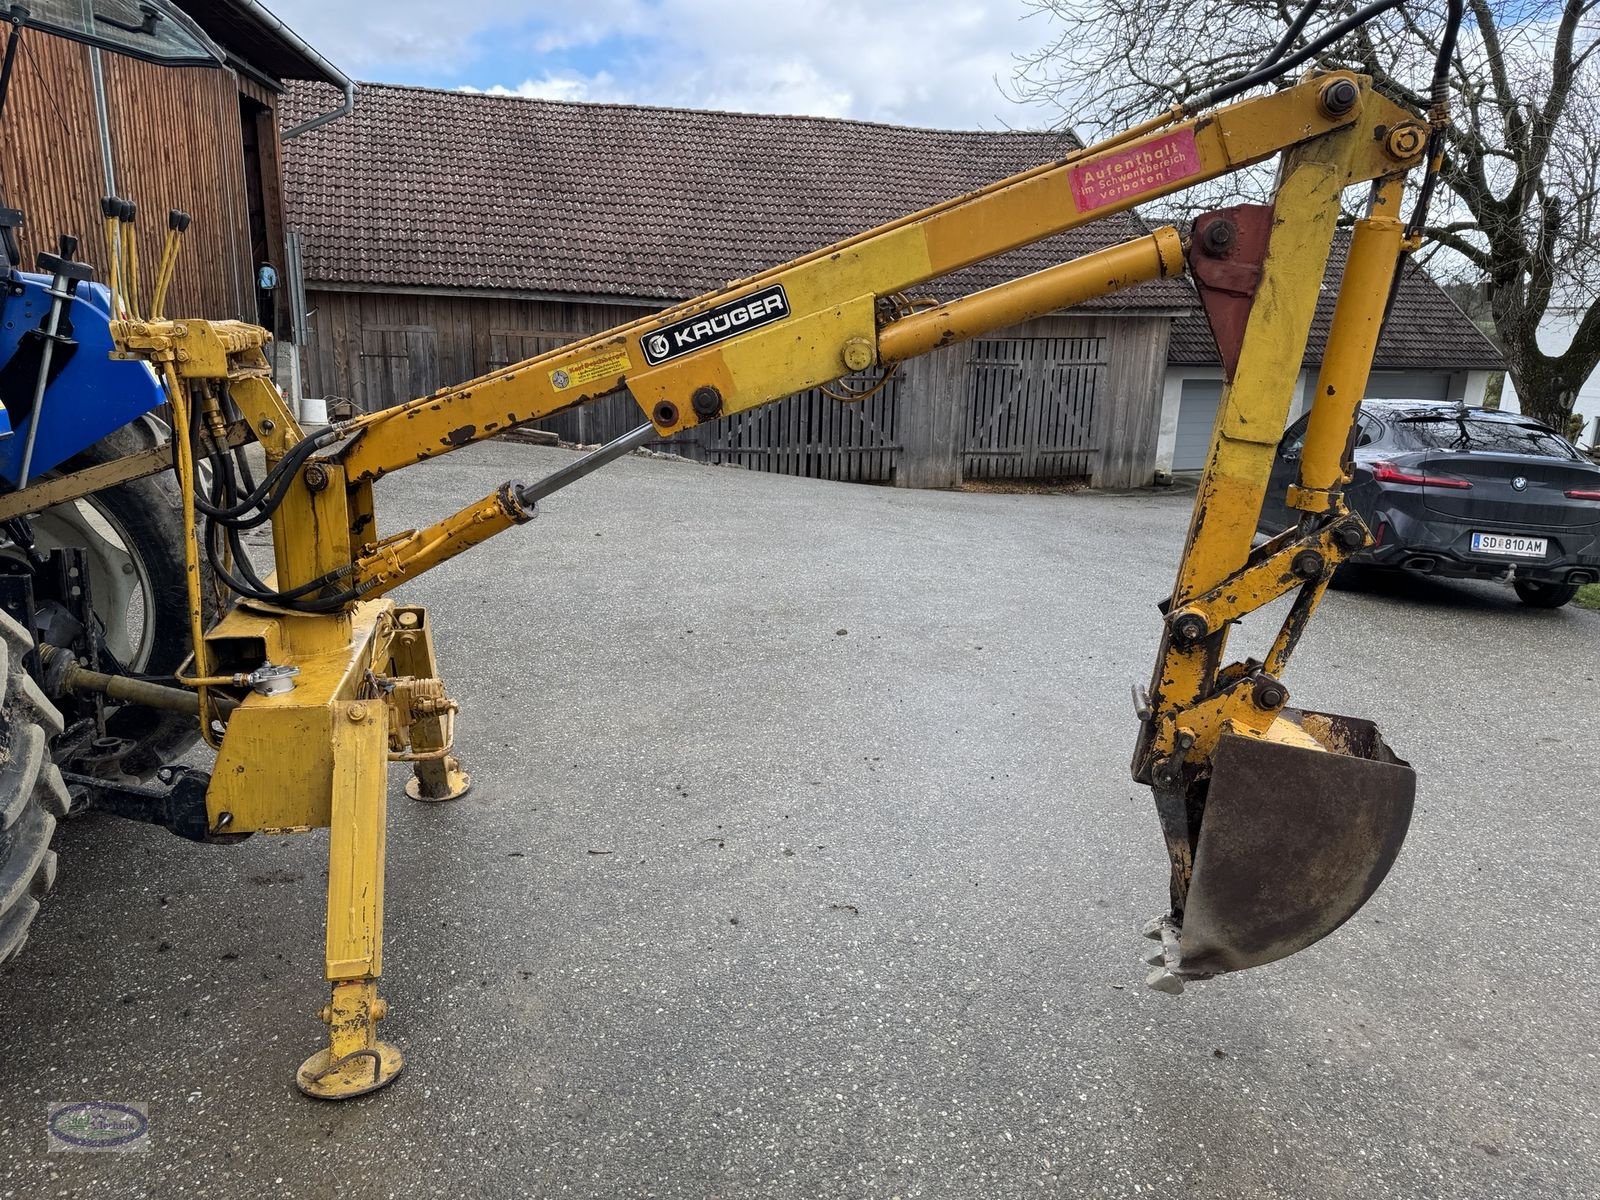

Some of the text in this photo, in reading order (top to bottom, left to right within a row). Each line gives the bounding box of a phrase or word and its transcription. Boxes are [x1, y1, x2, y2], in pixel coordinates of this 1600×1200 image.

[1081, 153, 1186, 196] im Schwenkbereich
[1084, 142, 1178, 184] Aufenthalt
[674, 294, 784, 347] KRÜGER
[1482, 536, 1497, 548] SD
[1504, 538, 1525, 551] 810
[1525, 540, 1542, 552] AM
